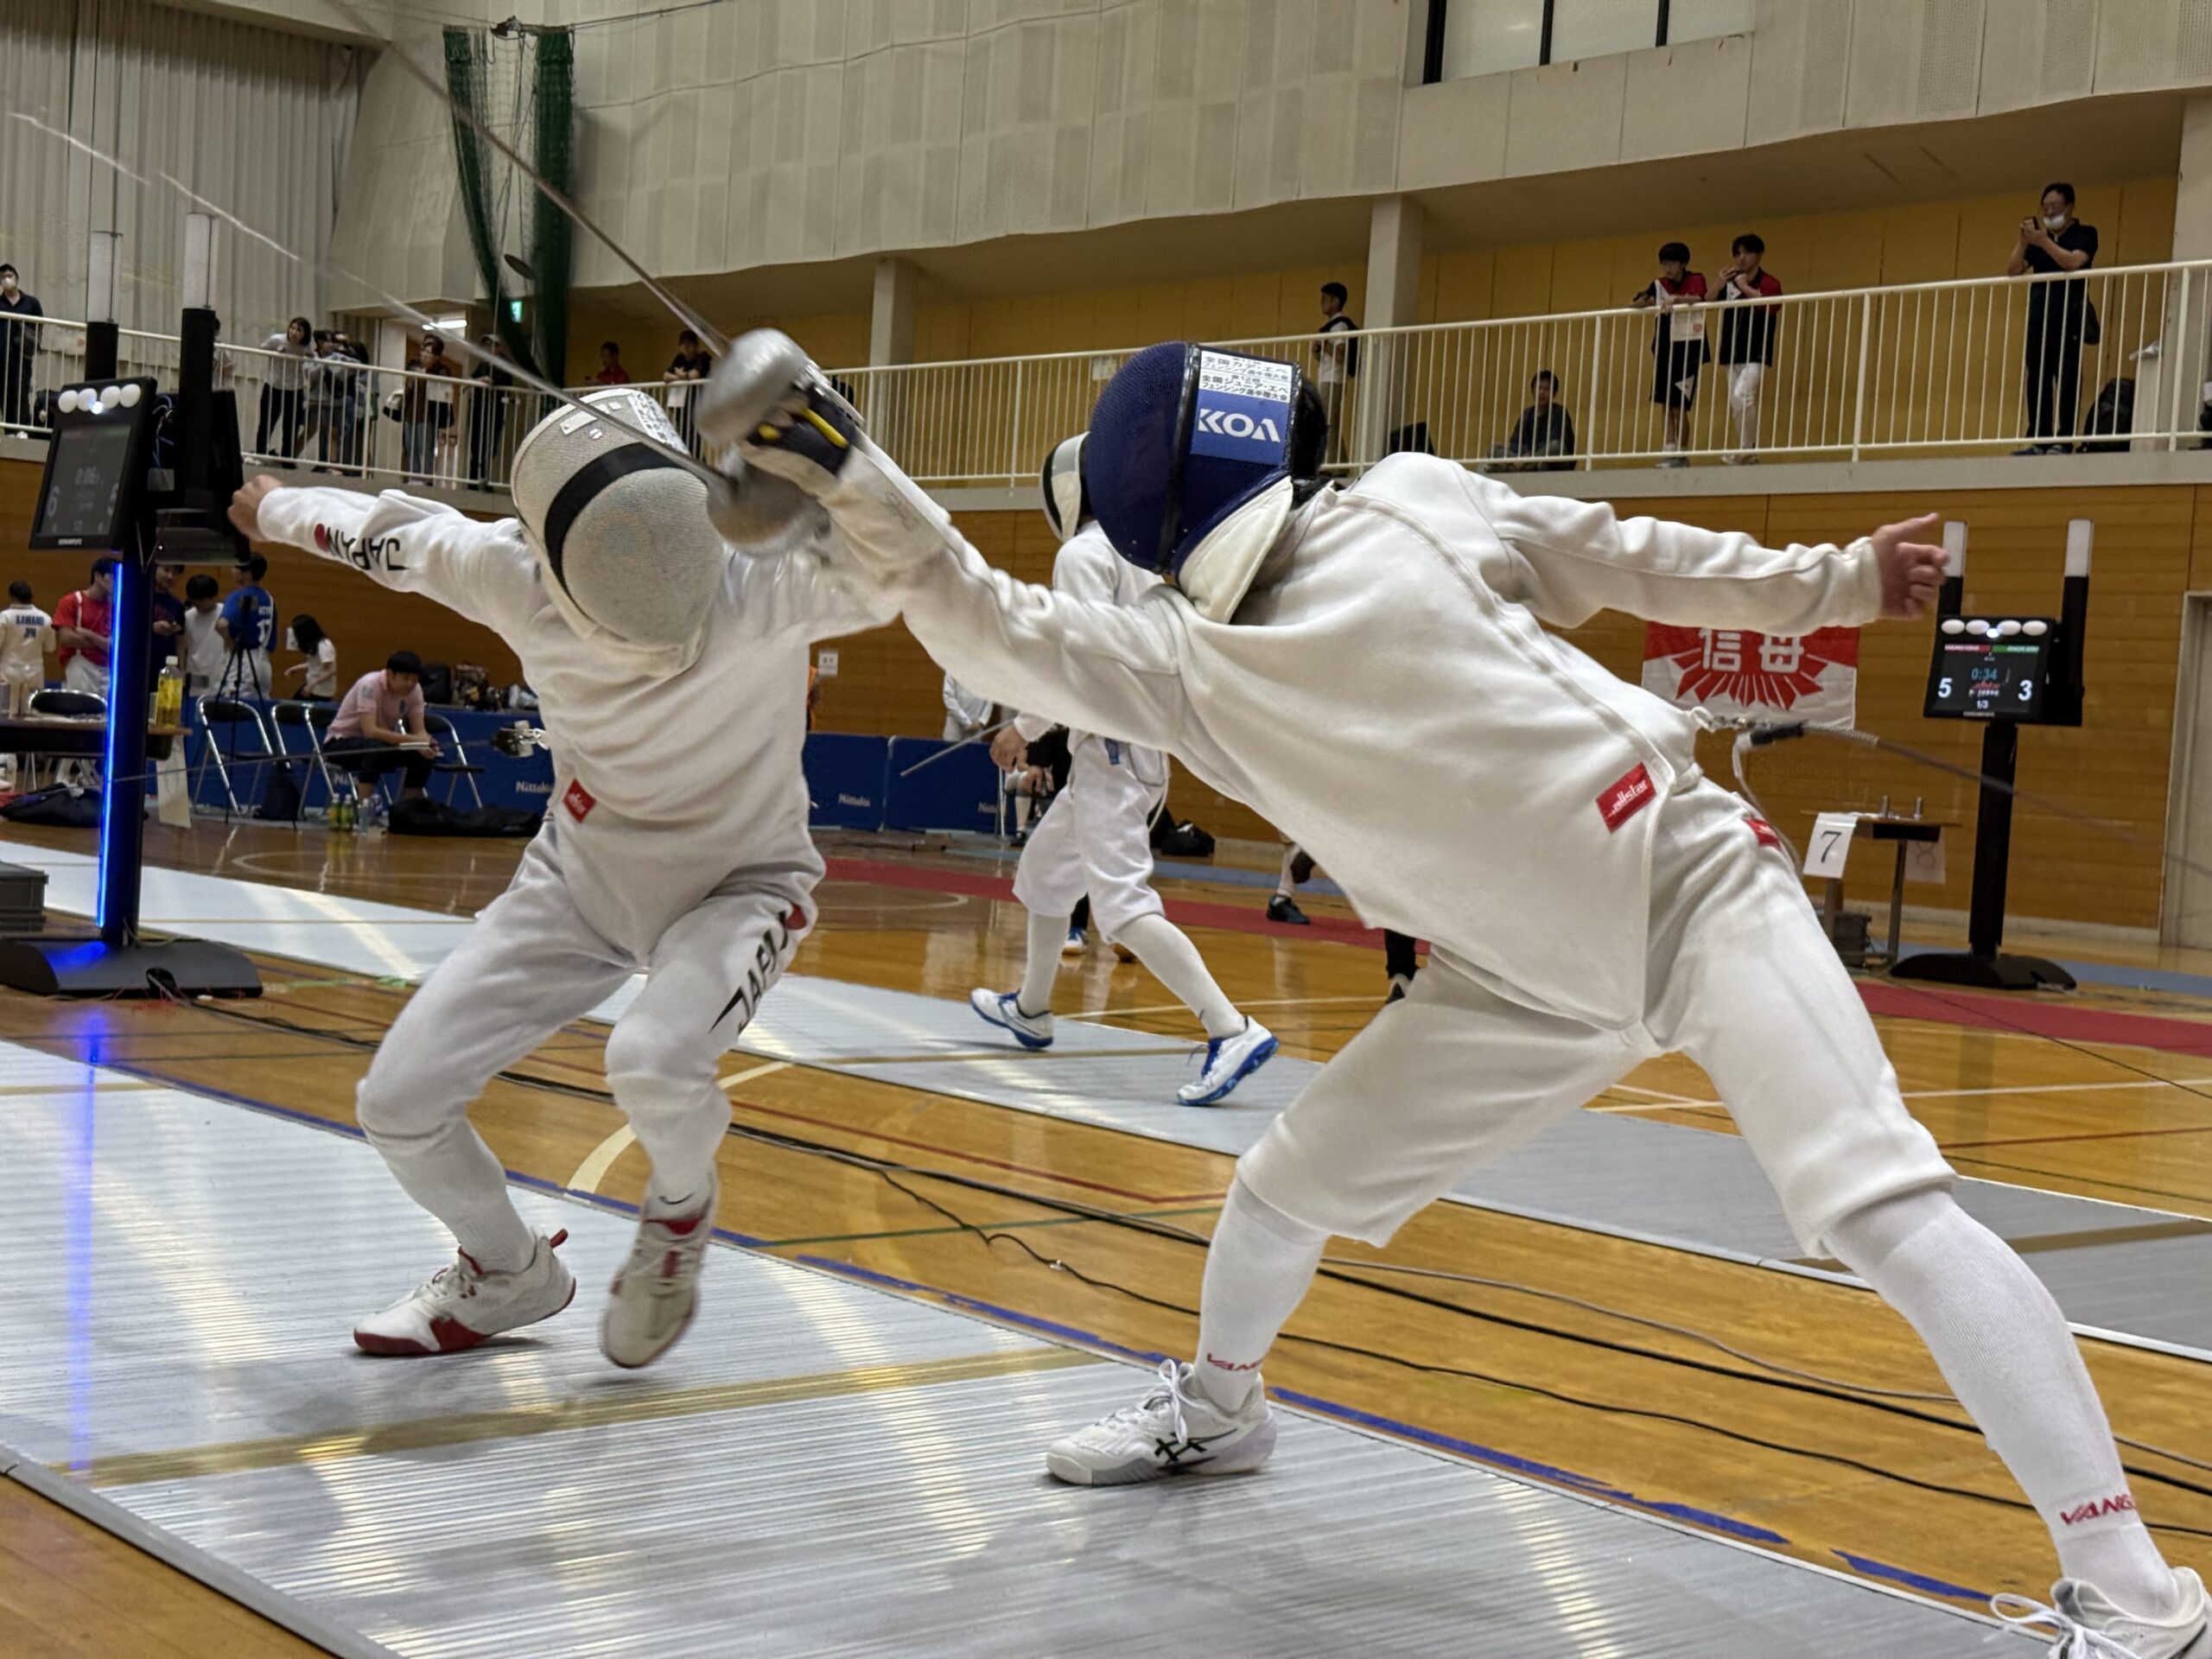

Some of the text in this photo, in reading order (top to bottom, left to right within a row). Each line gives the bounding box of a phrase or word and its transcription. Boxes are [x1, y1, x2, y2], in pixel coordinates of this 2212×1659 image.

[1198, 409, 1281, 442] KOA
[1938, 677, 1952, 698] 5
[2018, 680, 2033, 701] 3
[1971, 668, 1997, 680] 0:34
[1611, 779, 1648, 814] allstar
[1821, 830, 1842, 863] 7
